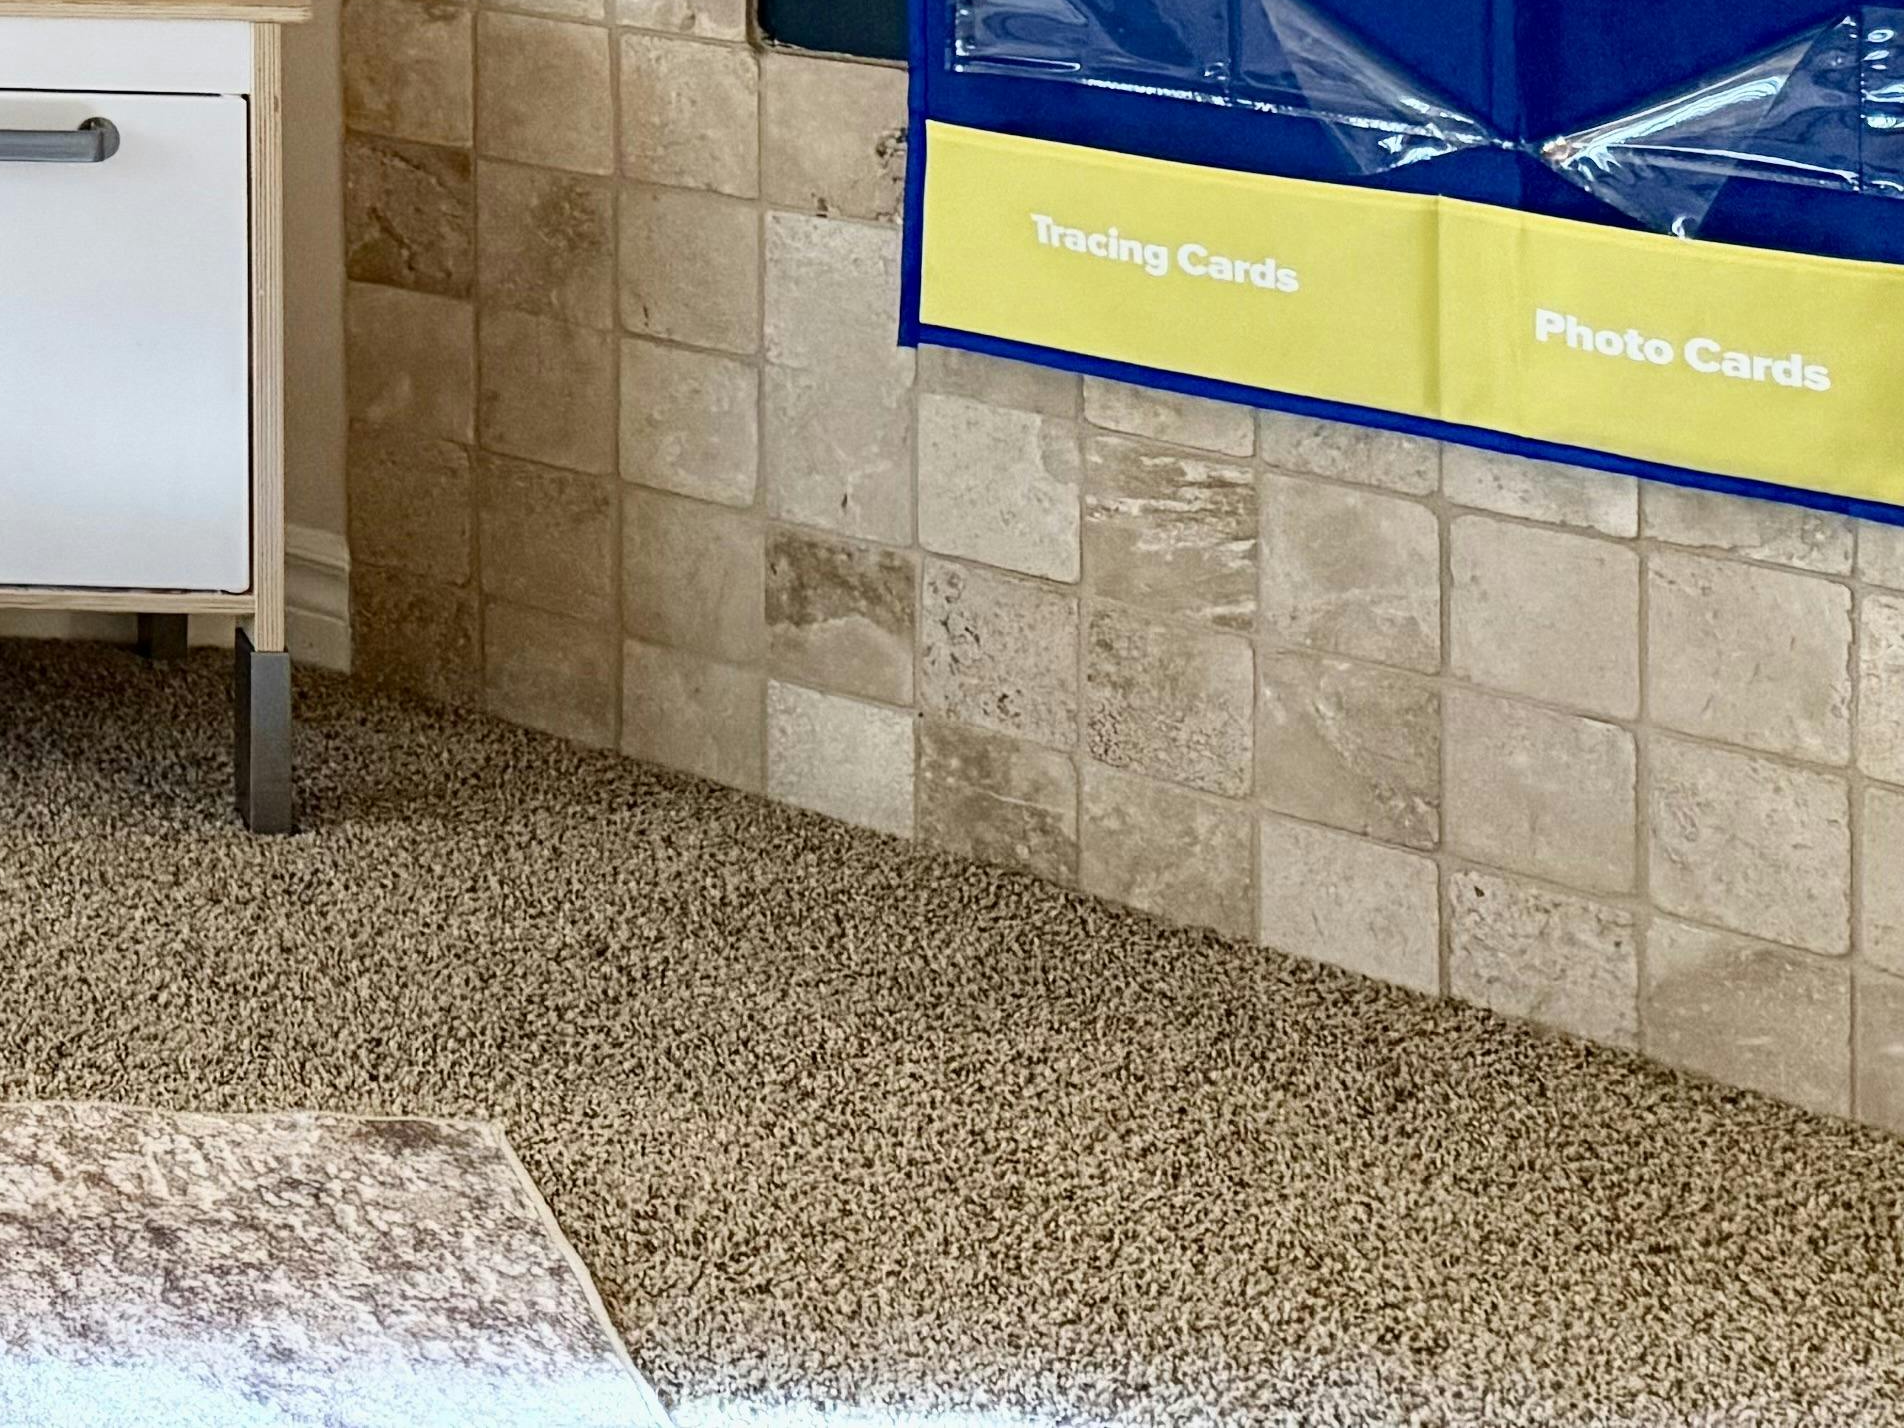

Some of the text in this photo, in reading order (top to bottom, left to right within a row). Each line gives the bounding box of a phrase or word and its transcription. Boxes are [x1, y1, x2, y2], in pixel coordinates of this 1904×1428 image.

[1030, 212, 1300, 294] Tracing Cards
[1534, 306, 1832, 393] Photo Cards
